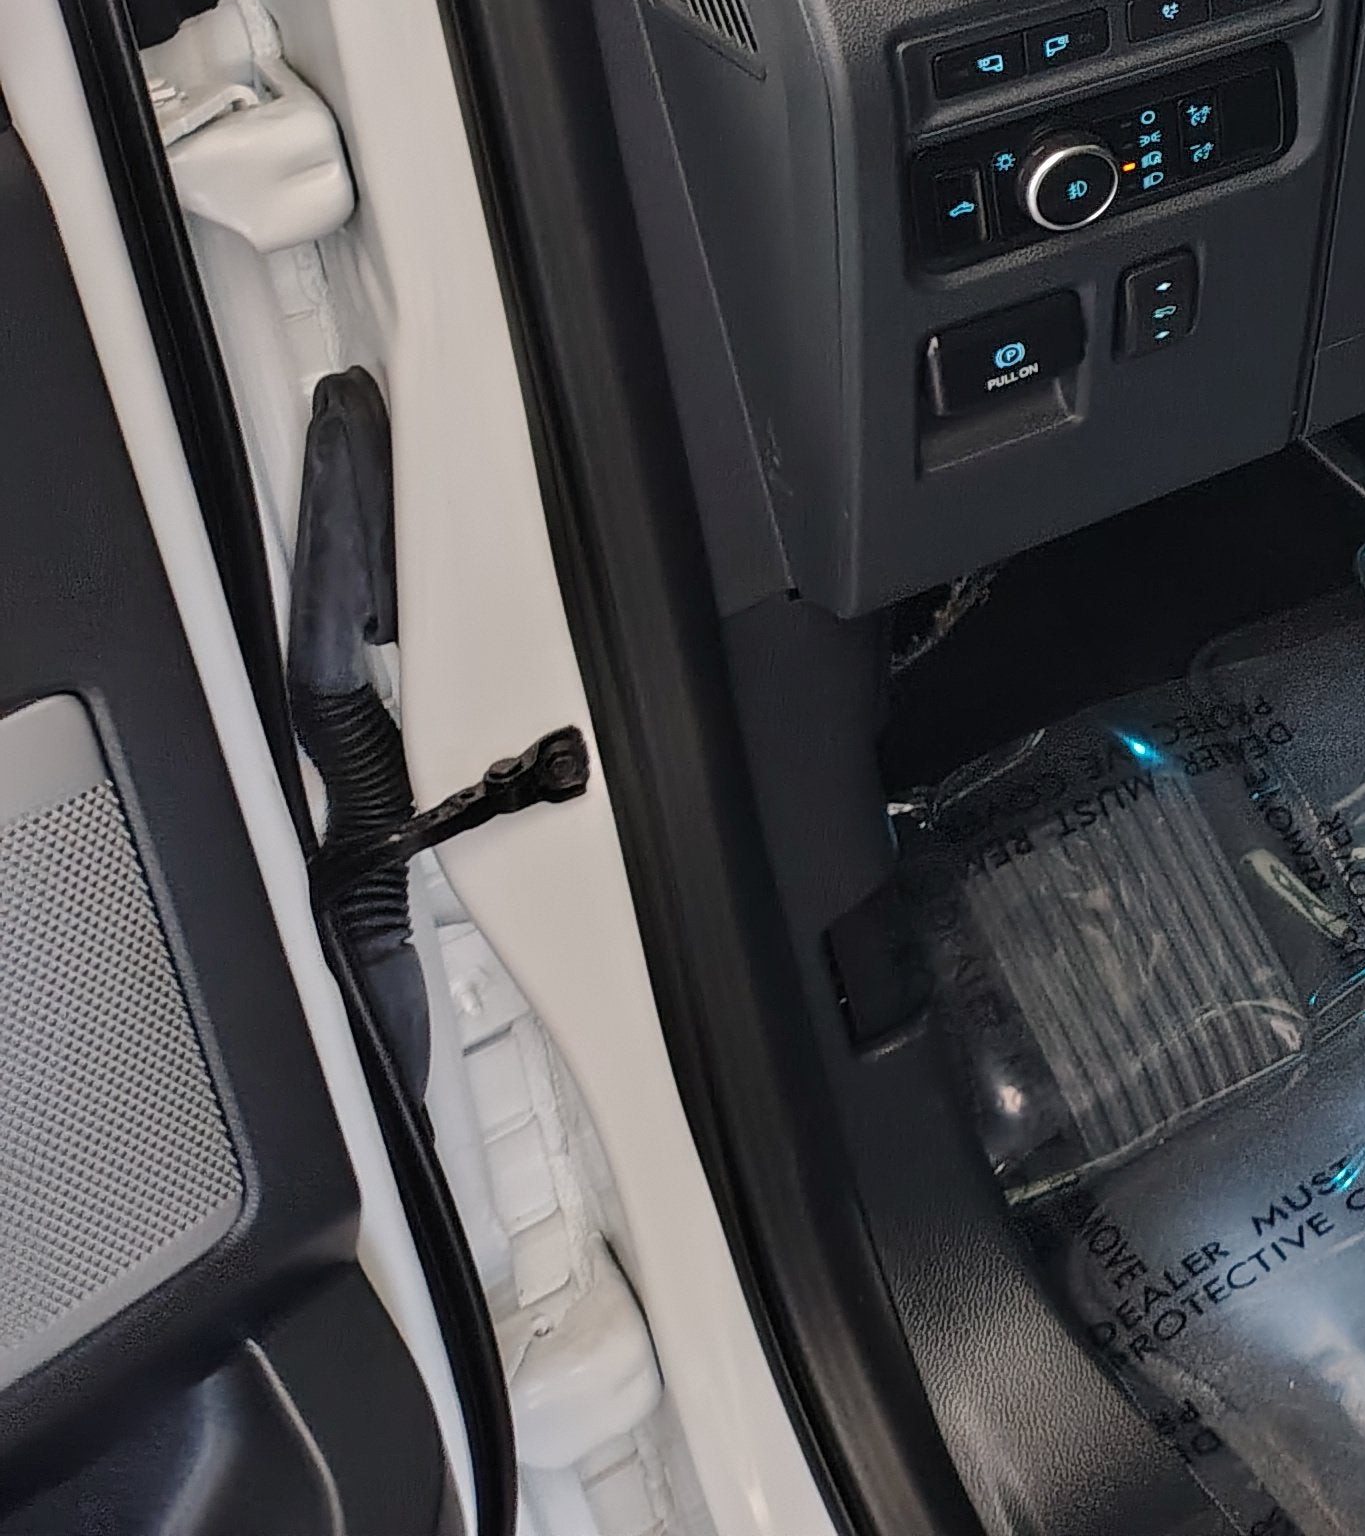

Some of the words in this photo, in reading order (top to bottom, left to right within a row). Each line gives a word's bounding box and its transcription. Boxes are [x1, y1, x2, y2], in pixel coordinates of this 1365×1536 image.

[986, 371, 1019, 392] PULL
[1018, 362, 1039, 379] ON
[1060, 772, 1156, 837] MUST
[1096, 1240, 1231, 1347] DEALER
[1251, 1155, 1354, 1237] MUST
